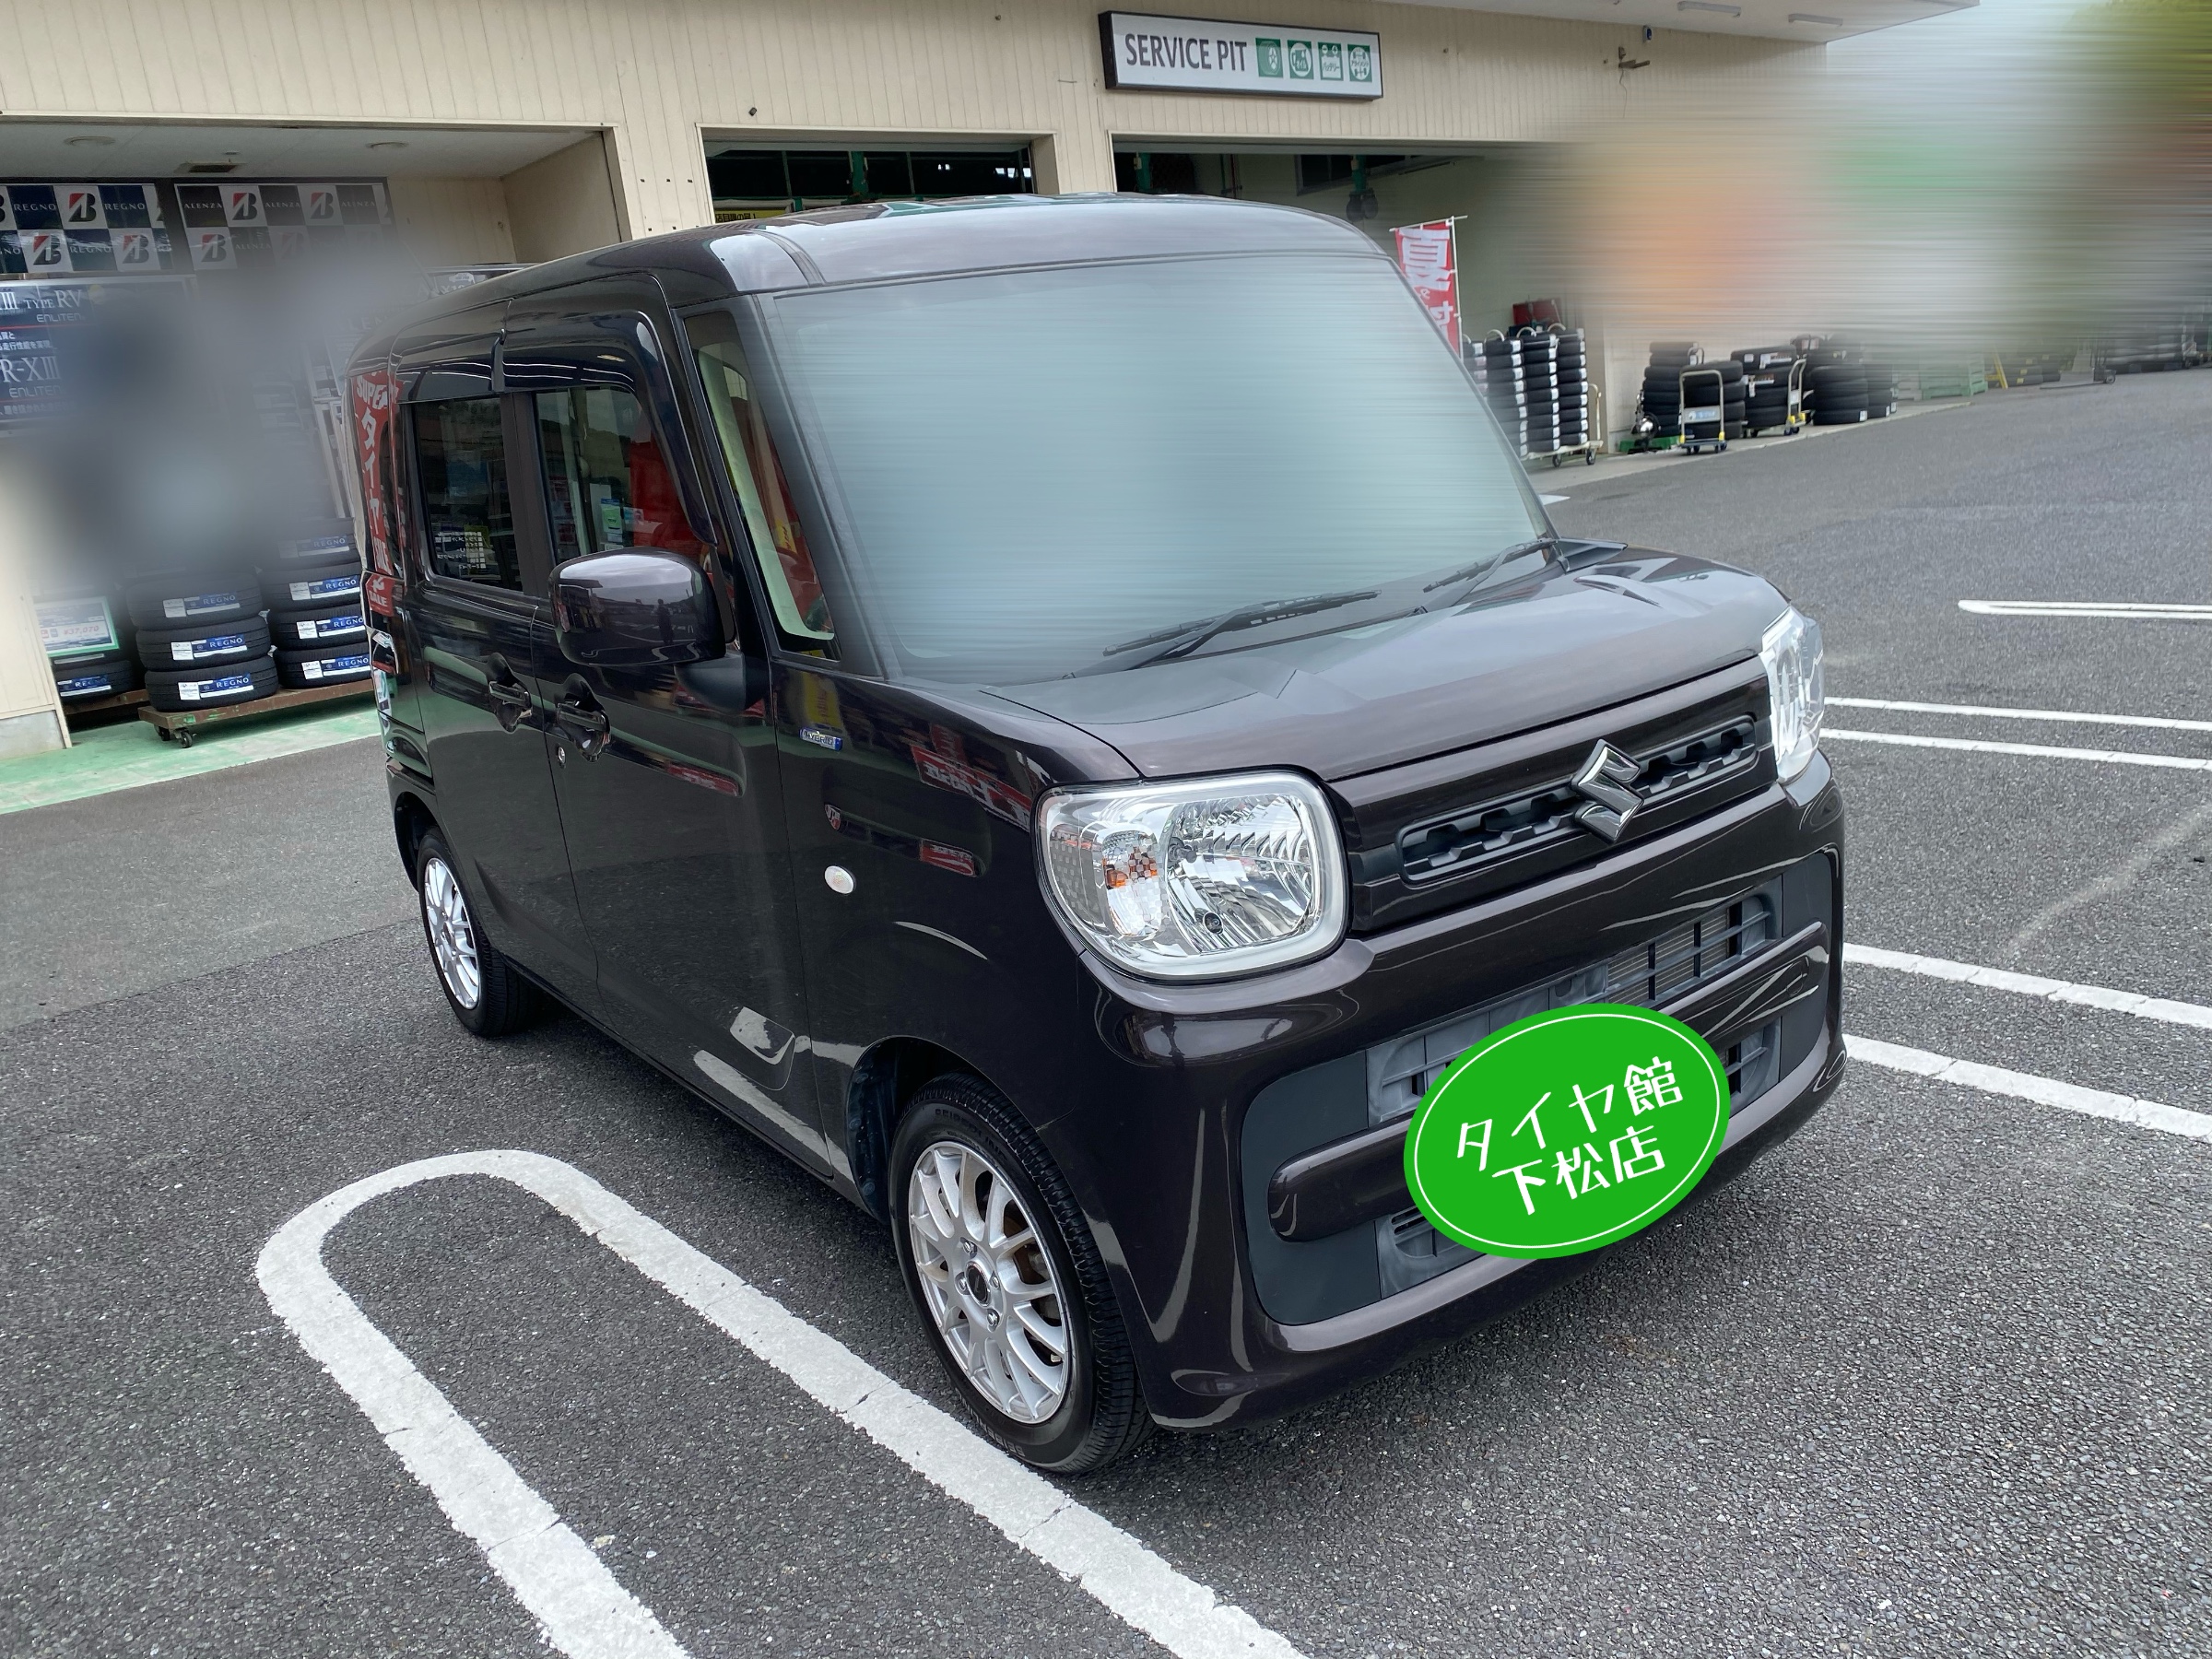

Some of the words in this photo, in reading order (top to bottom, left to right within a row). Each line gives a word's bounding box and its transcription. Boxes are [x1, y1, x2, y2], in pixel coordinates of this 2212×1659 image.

[1124, 33, 1212, 70] SERVICE
[1218, 41, 1247, 71] PIT
[13, 203, 56, 211] REGNO
[69, 245, 112, 254] REGNO
[235, 242, 271, 251] ALENZA
[23, 299, 55, 310] TYPE
[53, 288, 83, 309] RV
[313, 537, 346, 547] REGNO
[325, 579, 357, 590] REGNO
[202, 594, 236, 605] REGNO
[333, 617, 364, 628] REGNO
[209, 637, 243, 648] REGNO
[337, 657, 369, 667] REGNO
[75, 678, 107, 688] REGNO
[216, 677, 250, 688] REGNO
